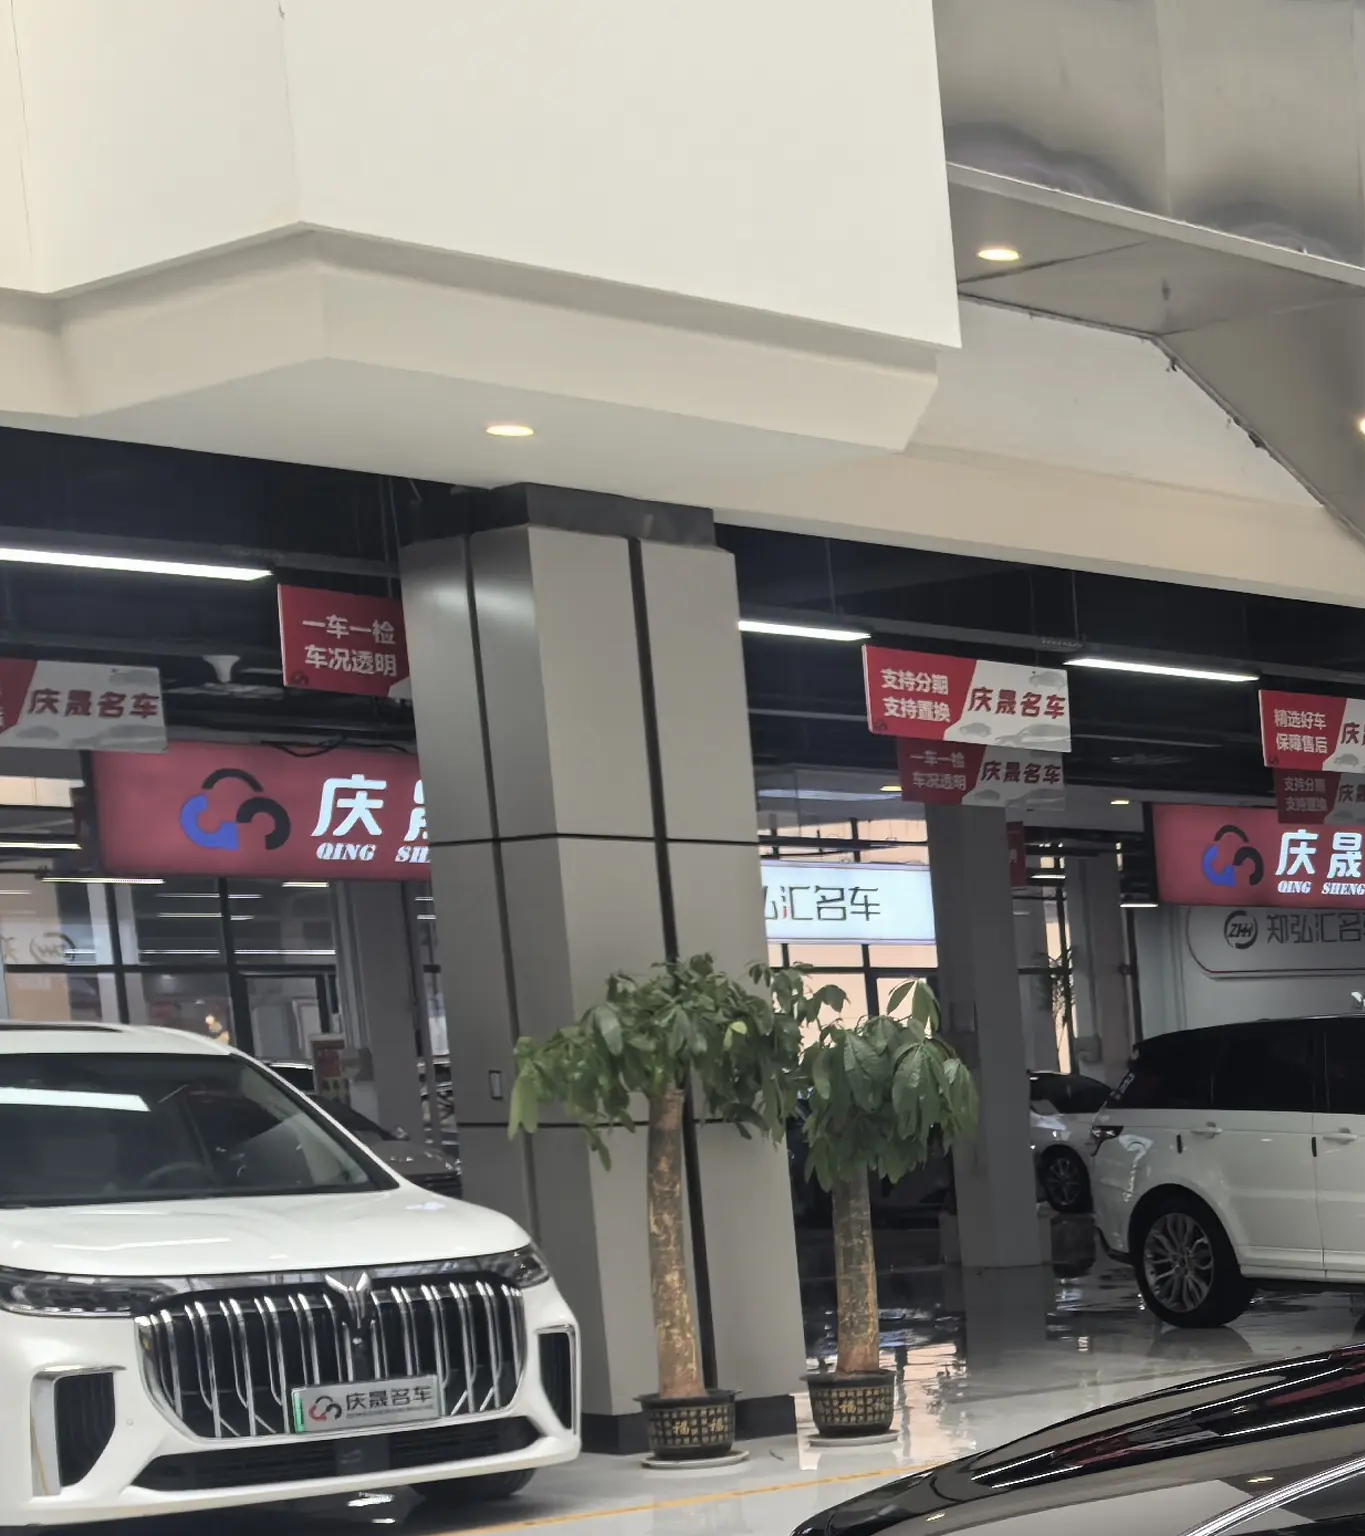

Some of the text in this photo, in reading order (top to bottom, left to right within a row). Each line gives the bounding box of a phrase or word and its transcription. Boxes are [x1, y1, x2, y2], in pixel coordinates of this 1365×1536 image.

[303, 614, 396, 644] 一车一检
[305, 644, 397, 676] 车况透明
[881, 669, 949, 695] 支持分期
[27, 688, 160, 718] 庆晟名车
[883, 697, 950, 722] 支持置换
[968, 687, 1065, 718] 庆晟名车
[1274, 709, 1327, 730] 精选好车
[1276, 733, 1328, 754] 保障售后
[980, 761, 1062, 784] 庆晟名车
[310, 774, 429, 841] 庆
[316, 842, 377, 861] QING
[1277, 881, 1312, 894] QING
[1321, 882, 1365, 896] SHENG
[346, 1386, 431, 1410] 庆晟名车
[672, 1420, 690, 1436] 福
